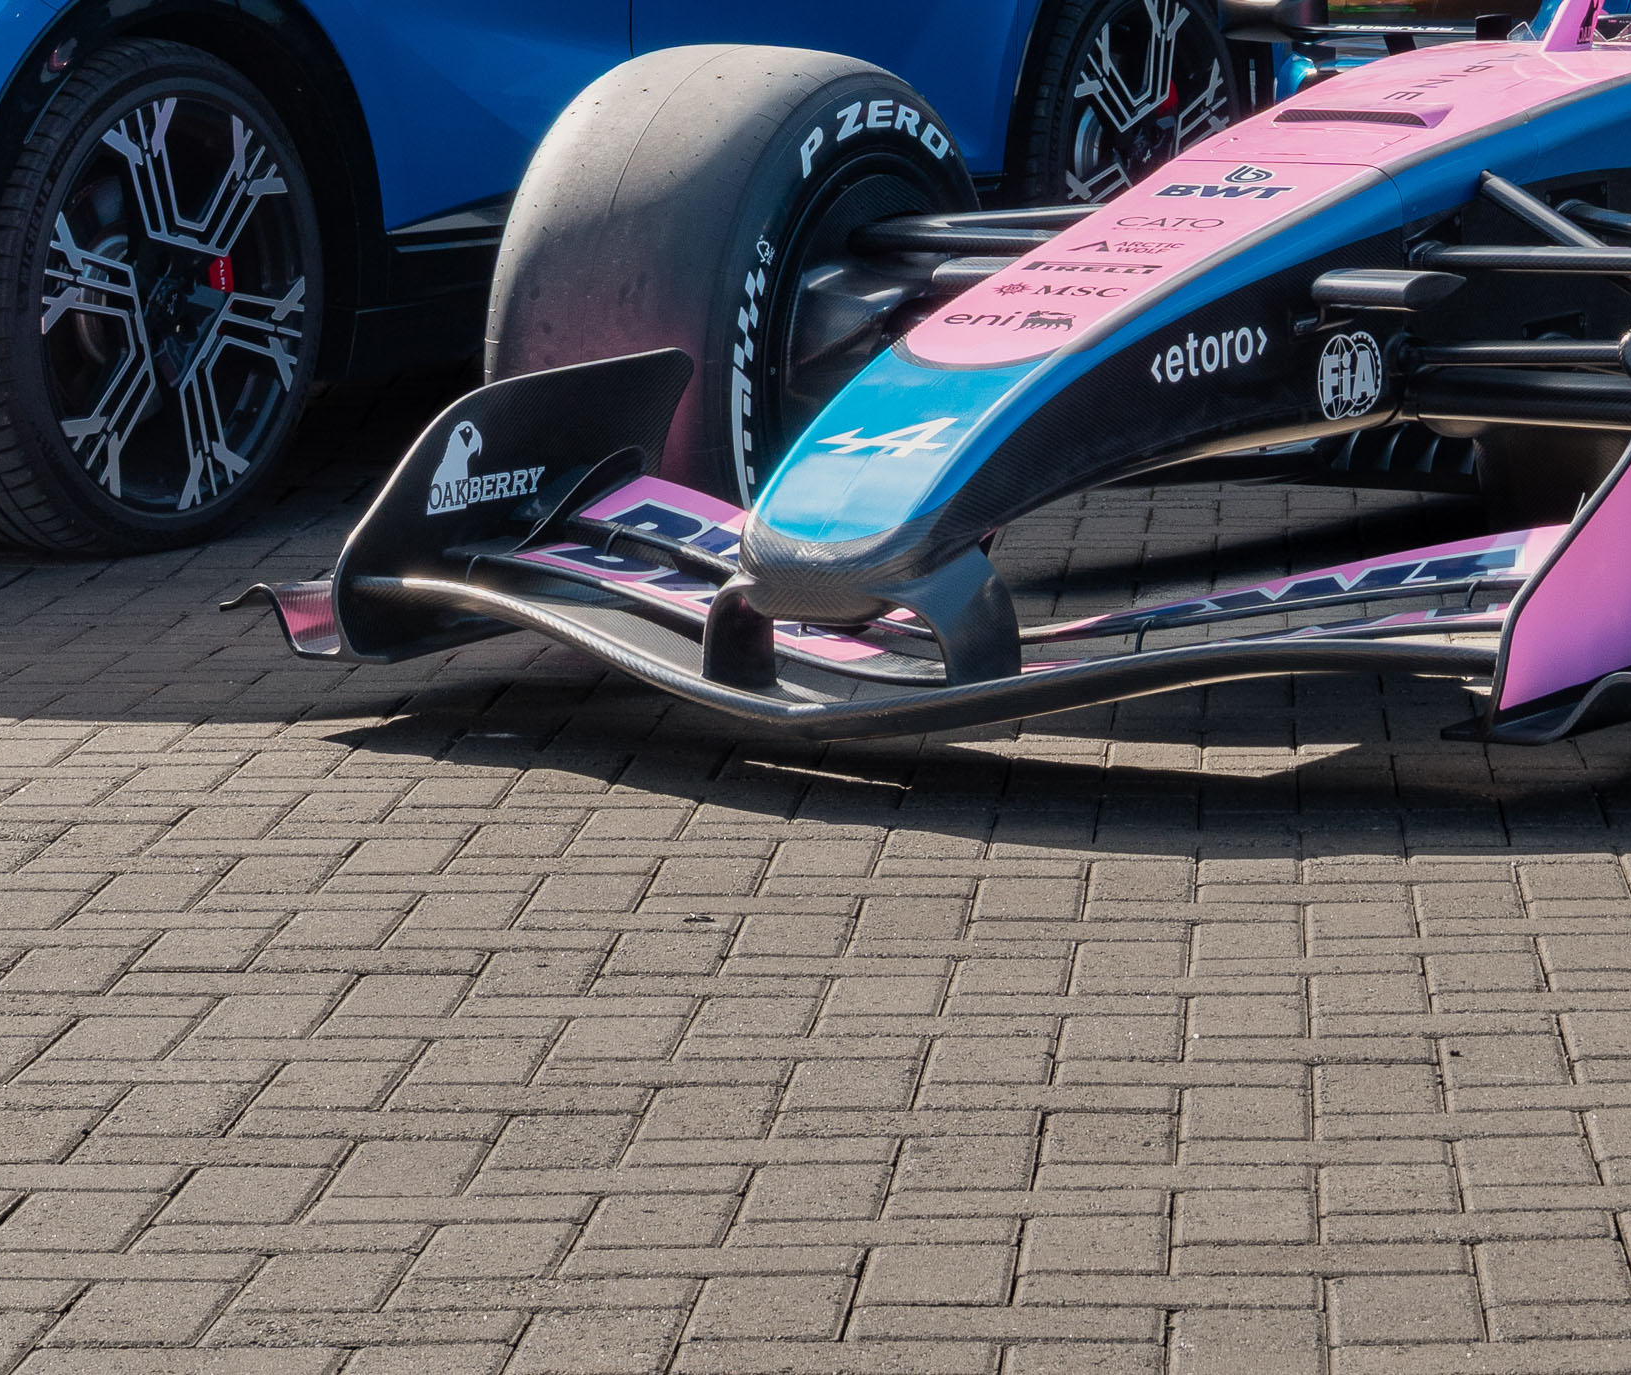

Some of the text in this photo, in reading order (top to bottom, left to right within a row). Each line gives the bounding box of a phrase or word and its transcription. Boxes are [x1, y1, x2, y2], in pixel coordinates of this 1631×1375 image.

[800, 126, 823, 179] P
[1151, 184, 1297, 201] BWT
[1116, 216, 1224, 230] CATO
[1113, 240, 1186, 250] ARCTIC
[1116, 246, 1177, 256] WOLF
[1022, 261, 1163, 275] PIRELLI
[1033, 284, 1128, 298] MSC
[943, 311, 1023, 327] eni
[429, 466, 546, 511] OAKBERRY
